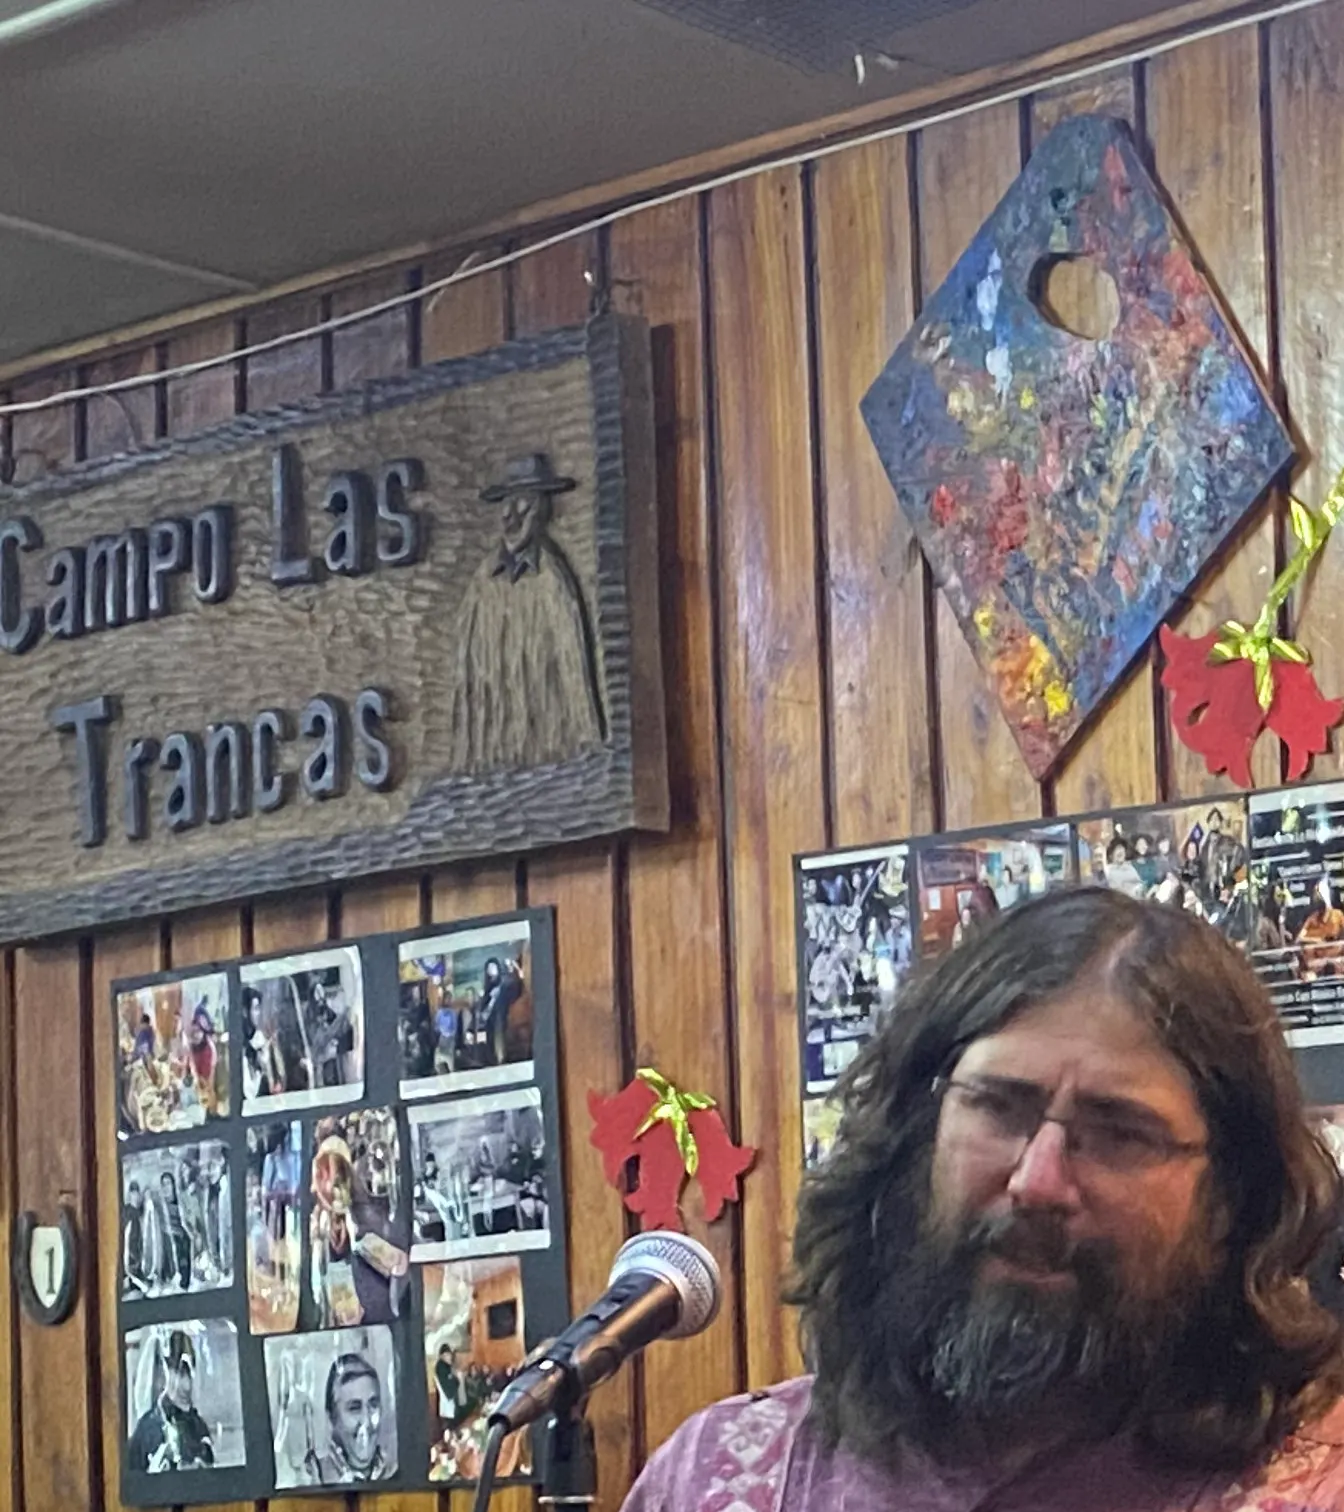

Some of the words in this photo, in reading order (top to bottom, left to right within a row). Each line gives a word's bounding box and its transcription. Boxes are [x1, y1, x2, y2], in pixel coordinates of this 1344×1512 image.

[0, 505, 232, 655] Campo
[271, 442, 425, 586] Las
[51, 686, 396, 848] Trancas
[44, 1245, 56, 1295] 1
